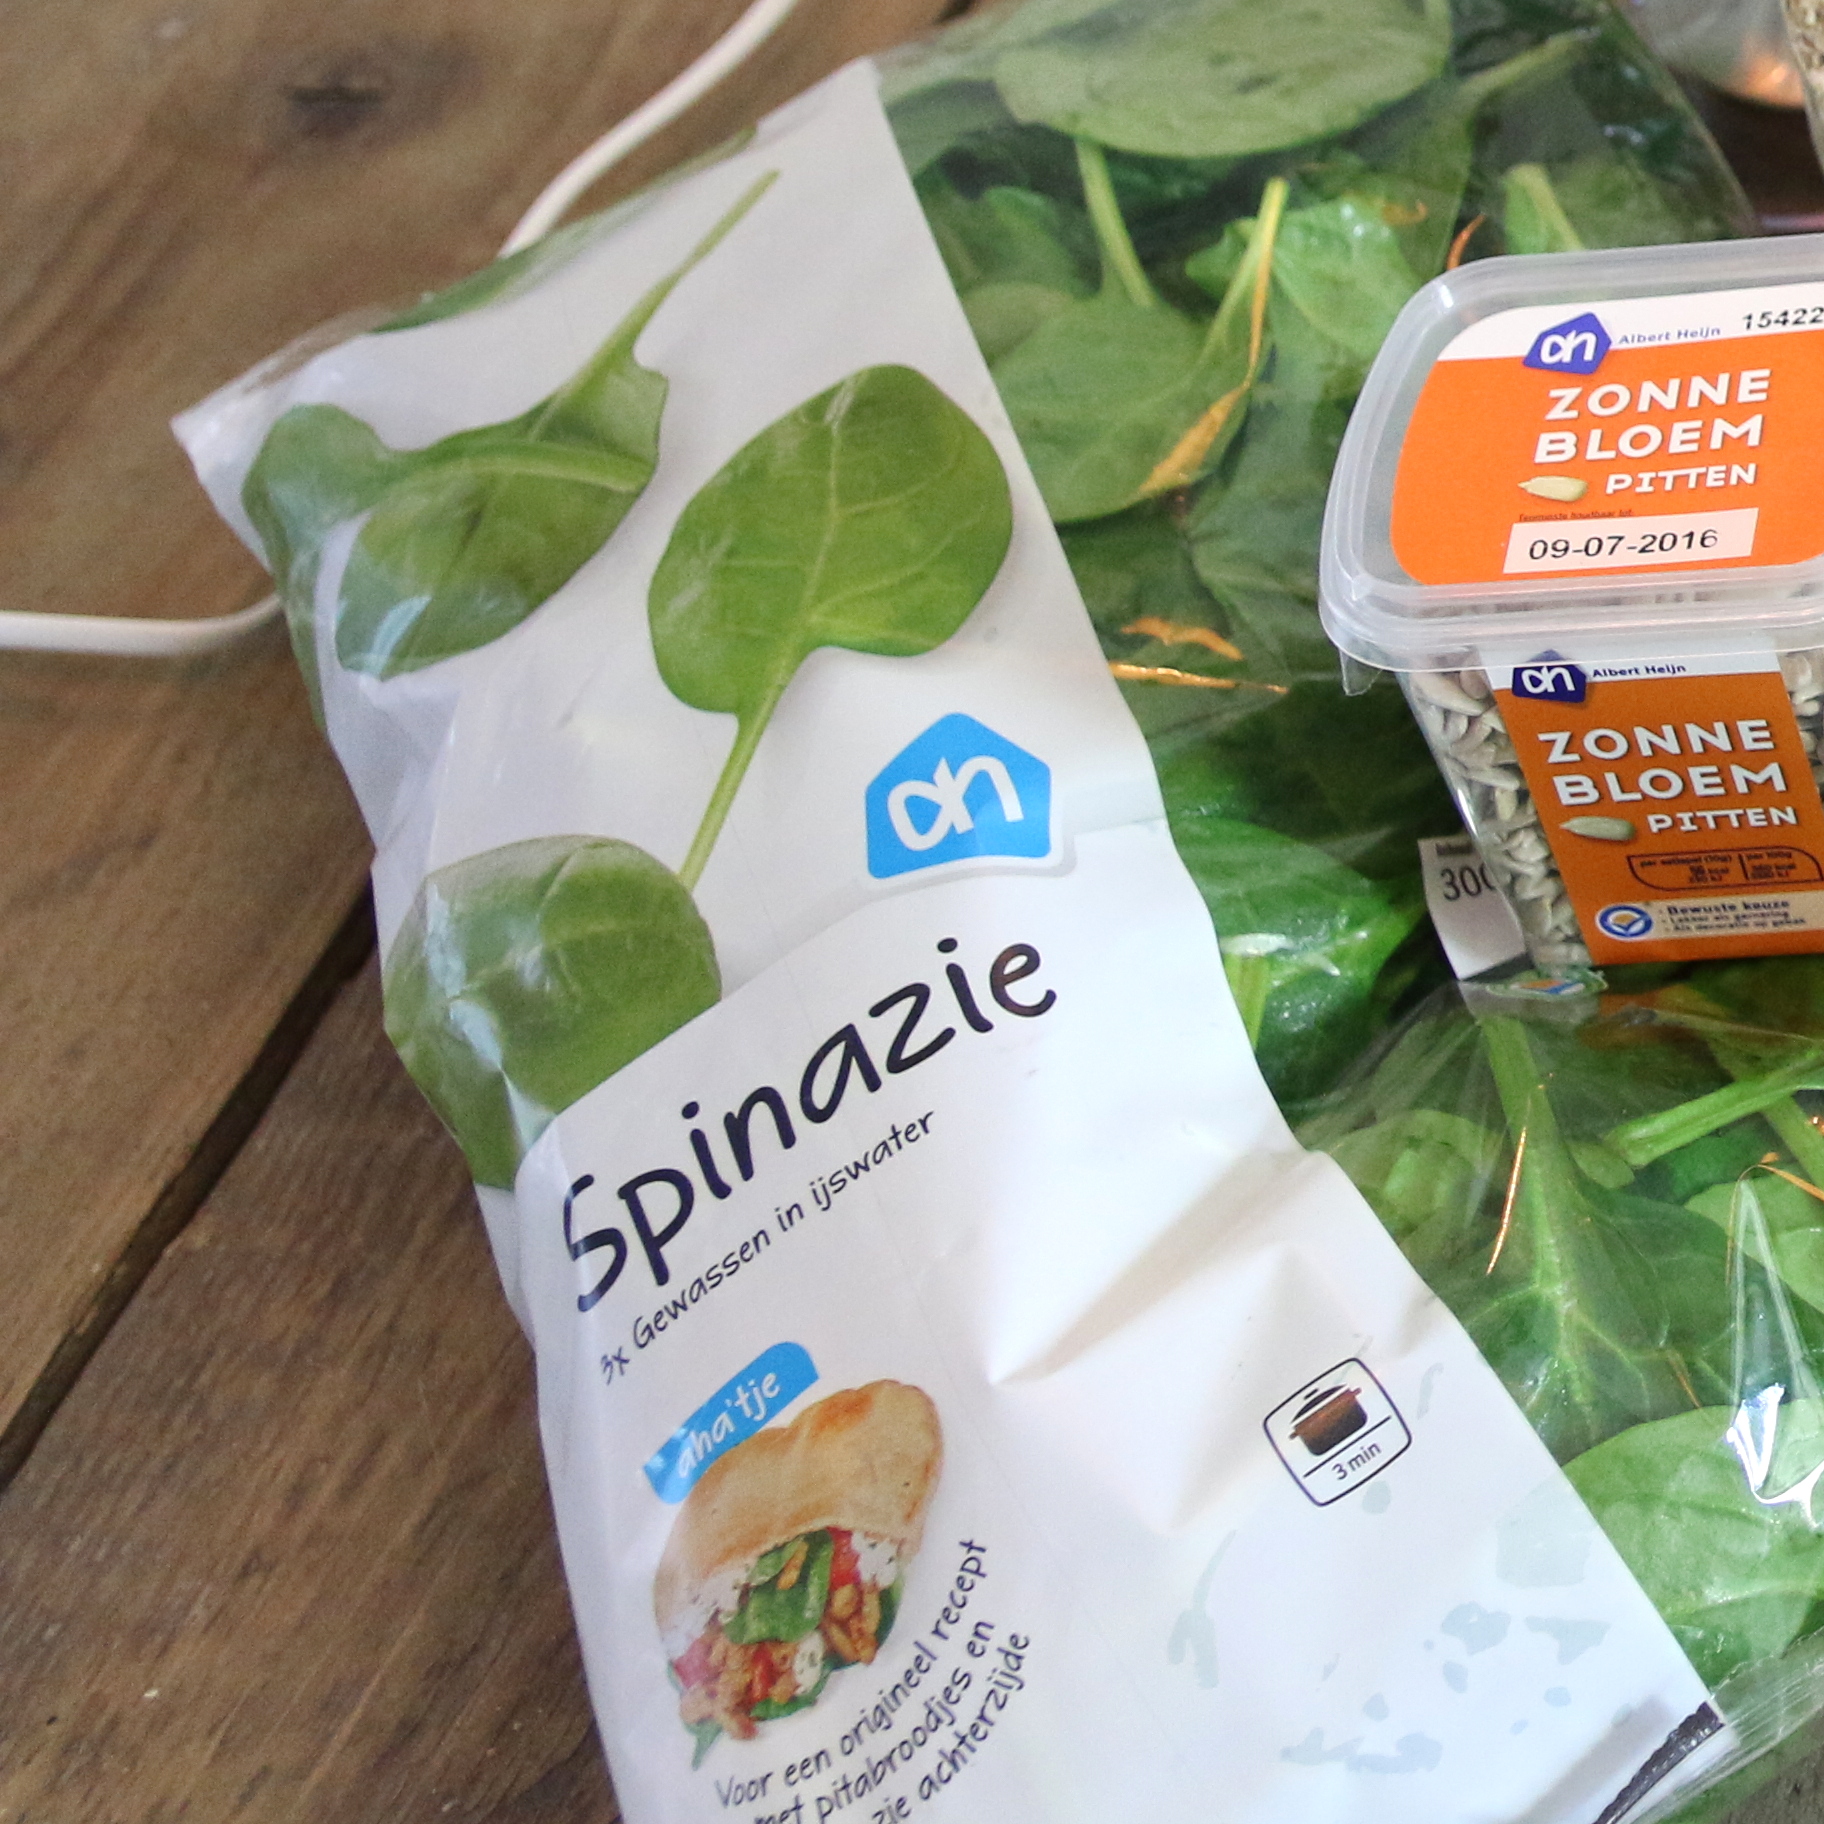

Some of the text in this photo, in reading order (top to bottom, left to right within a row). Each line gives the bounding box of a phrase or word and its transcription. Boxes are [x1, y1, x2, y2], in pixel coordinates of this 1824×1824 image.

[1618, 330, 1670, 345] Albert
[1677, 327, 1722, 342] Heijn
[1544, 368, 1772, 421] ZONNE
[1533, 412, 1764, 464] BLOEM
[1605, 462, 1757, 495] PITTEN
[1528, 528, 1719, 561] 09-07-2016
[1592, 665, 1640, 679] Albert
[1645, 662, 1687, 676] Heijn
[1537, 719, 1776, 764] ZONNE
[1552, 762, 1788, 807] BLOEM
[1647, 806, 1799, 834] PITTEN
[1667, 900, 1790, 916] Bewuste keuze
[562, 937, 1057, 1313] Spinazie
[602, 1110, 936, 1386] 3x Gewassen in ijswater
[1331, 1442, 1383, 1480] 3 min
[714, 1538, 988, 1809] Voor een origineel recept
[815, 1666, 973, 1824] pitabroodjes
[966, 1619, 996, 1660] en
[871, 1631, 1031, 1824] zie achterzijde
